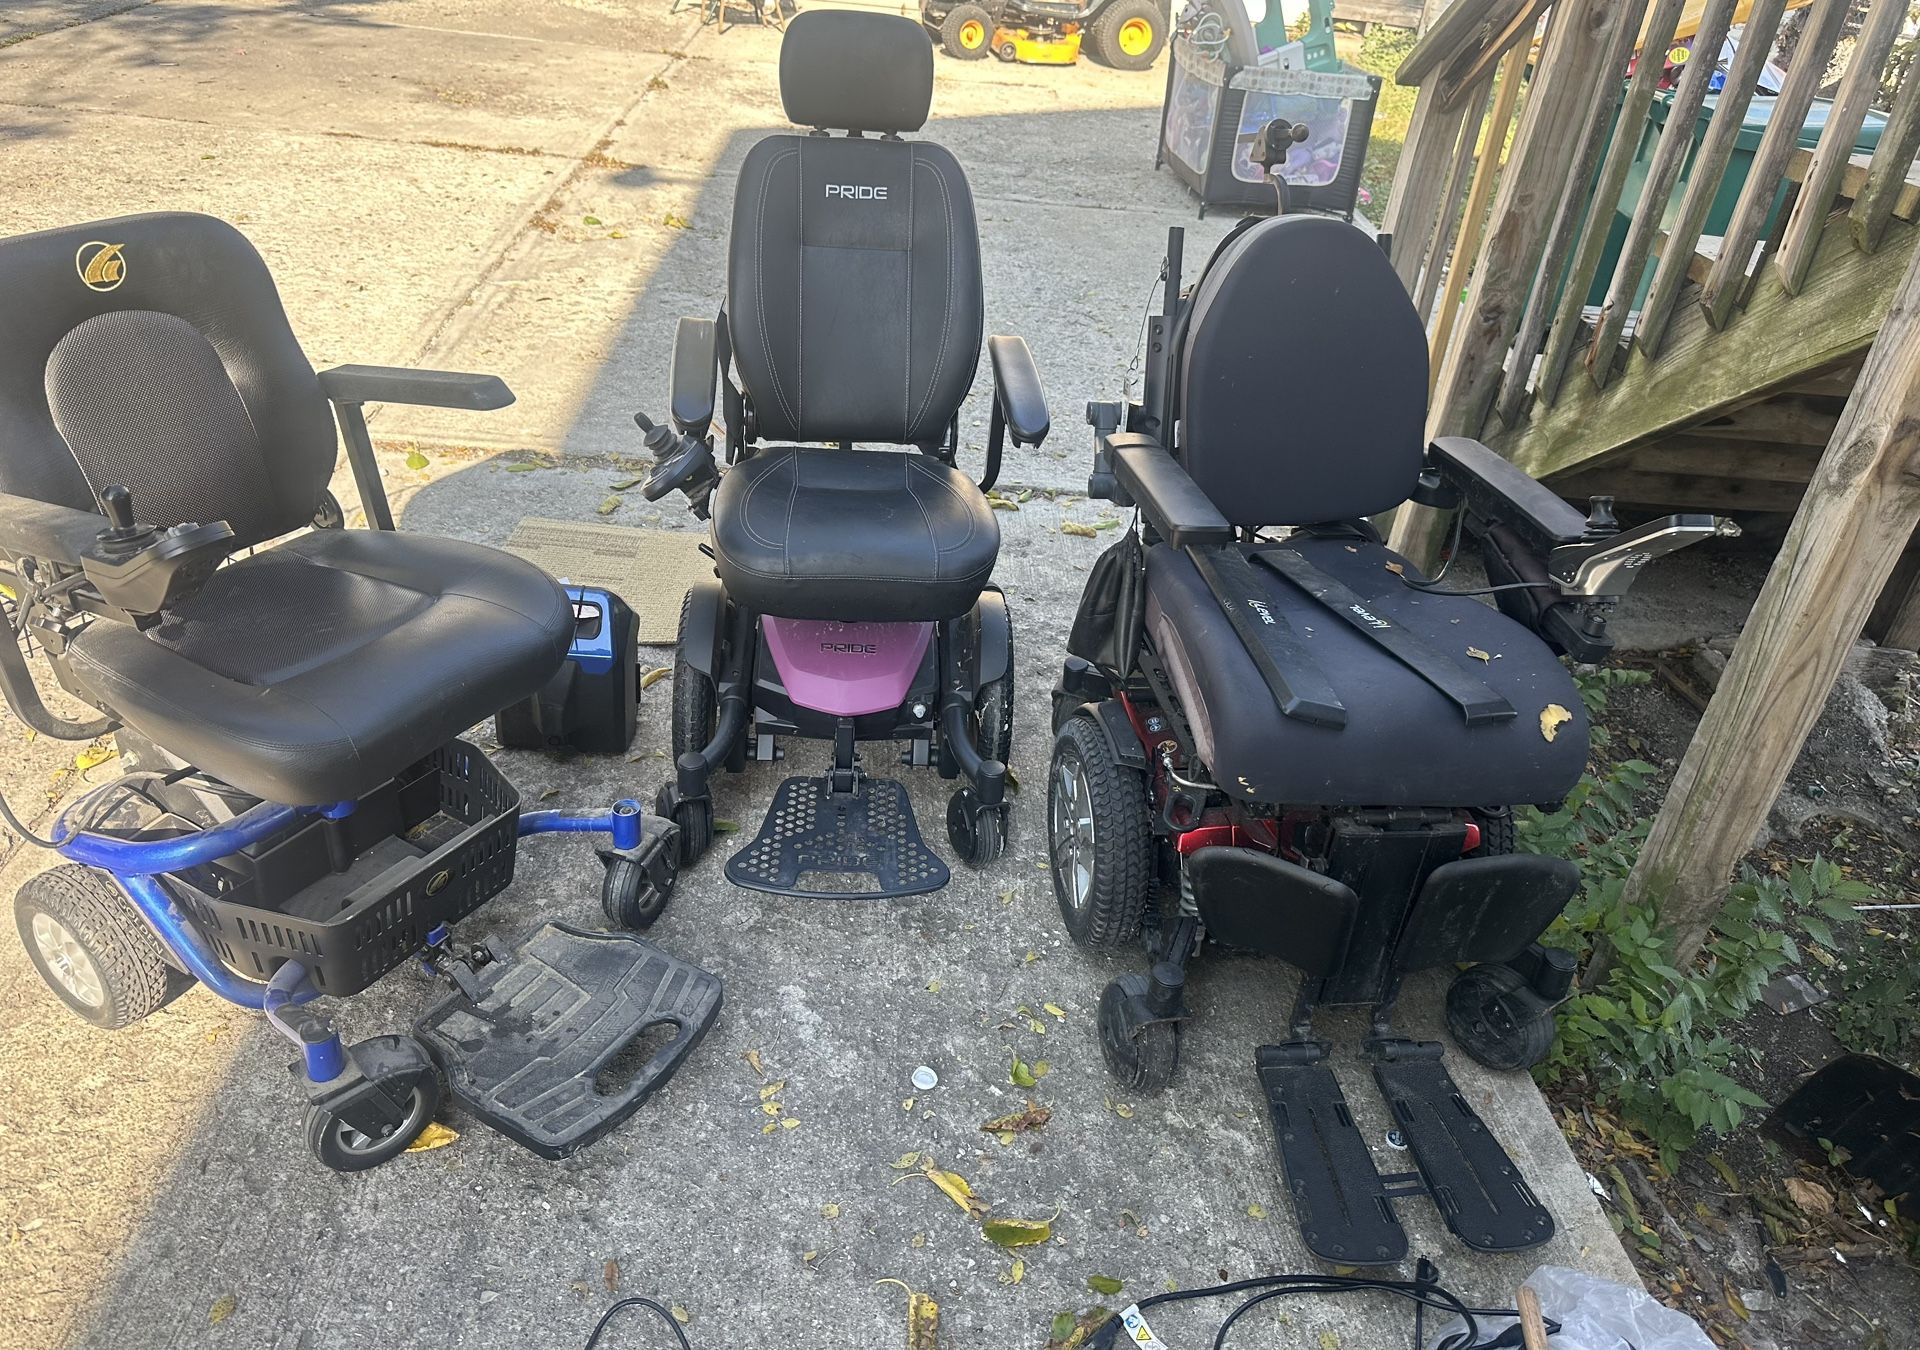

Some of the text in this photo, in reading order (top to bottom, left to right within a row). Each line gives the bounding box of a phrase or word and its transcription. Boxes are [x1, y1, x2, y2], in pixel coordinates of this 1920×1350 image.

[825, 184, 888, 200] PRIDE
[820, 642, 877, 654] PRIDE
[117, 896, 164, 955] GOLDEN
